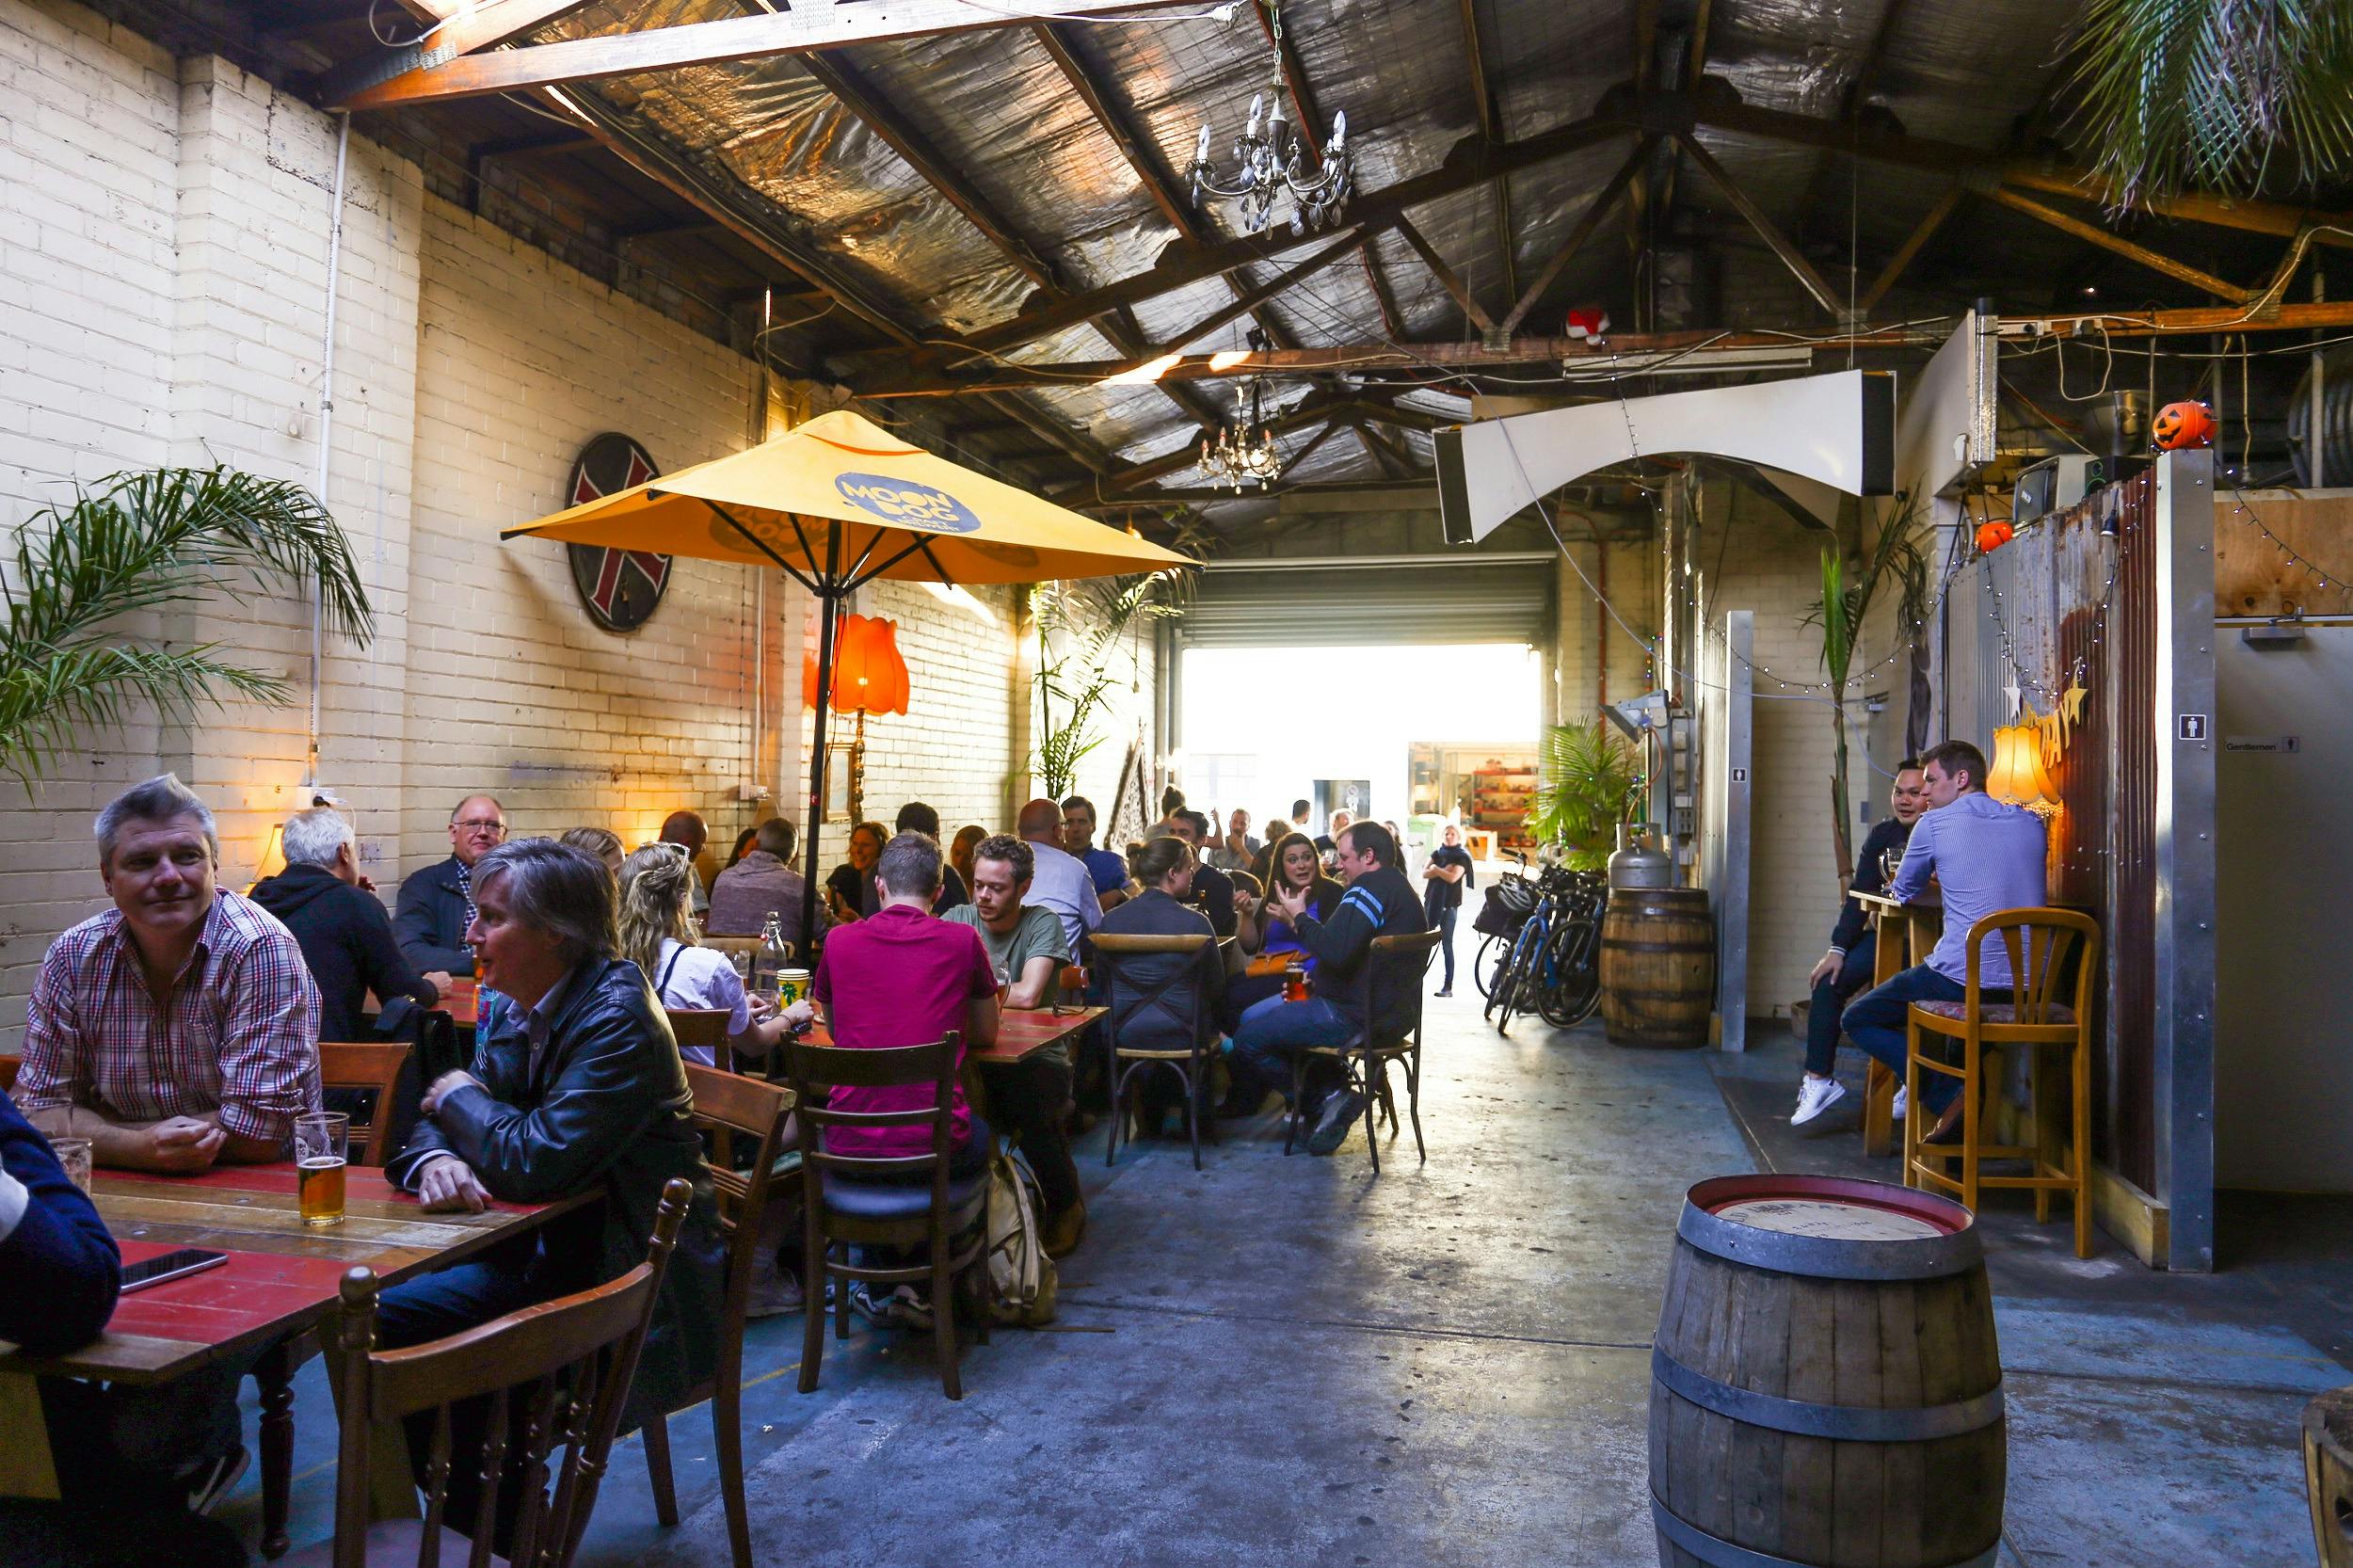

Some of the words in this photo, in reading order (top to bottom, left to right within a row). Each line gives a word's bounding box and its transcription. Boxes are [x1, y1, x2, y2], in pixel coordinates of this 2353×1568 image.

[840, 481, 953, 509] MOON
[874, 500, 960, 521] DOG
[2226, 742, 2277, 752] Gentlemen
